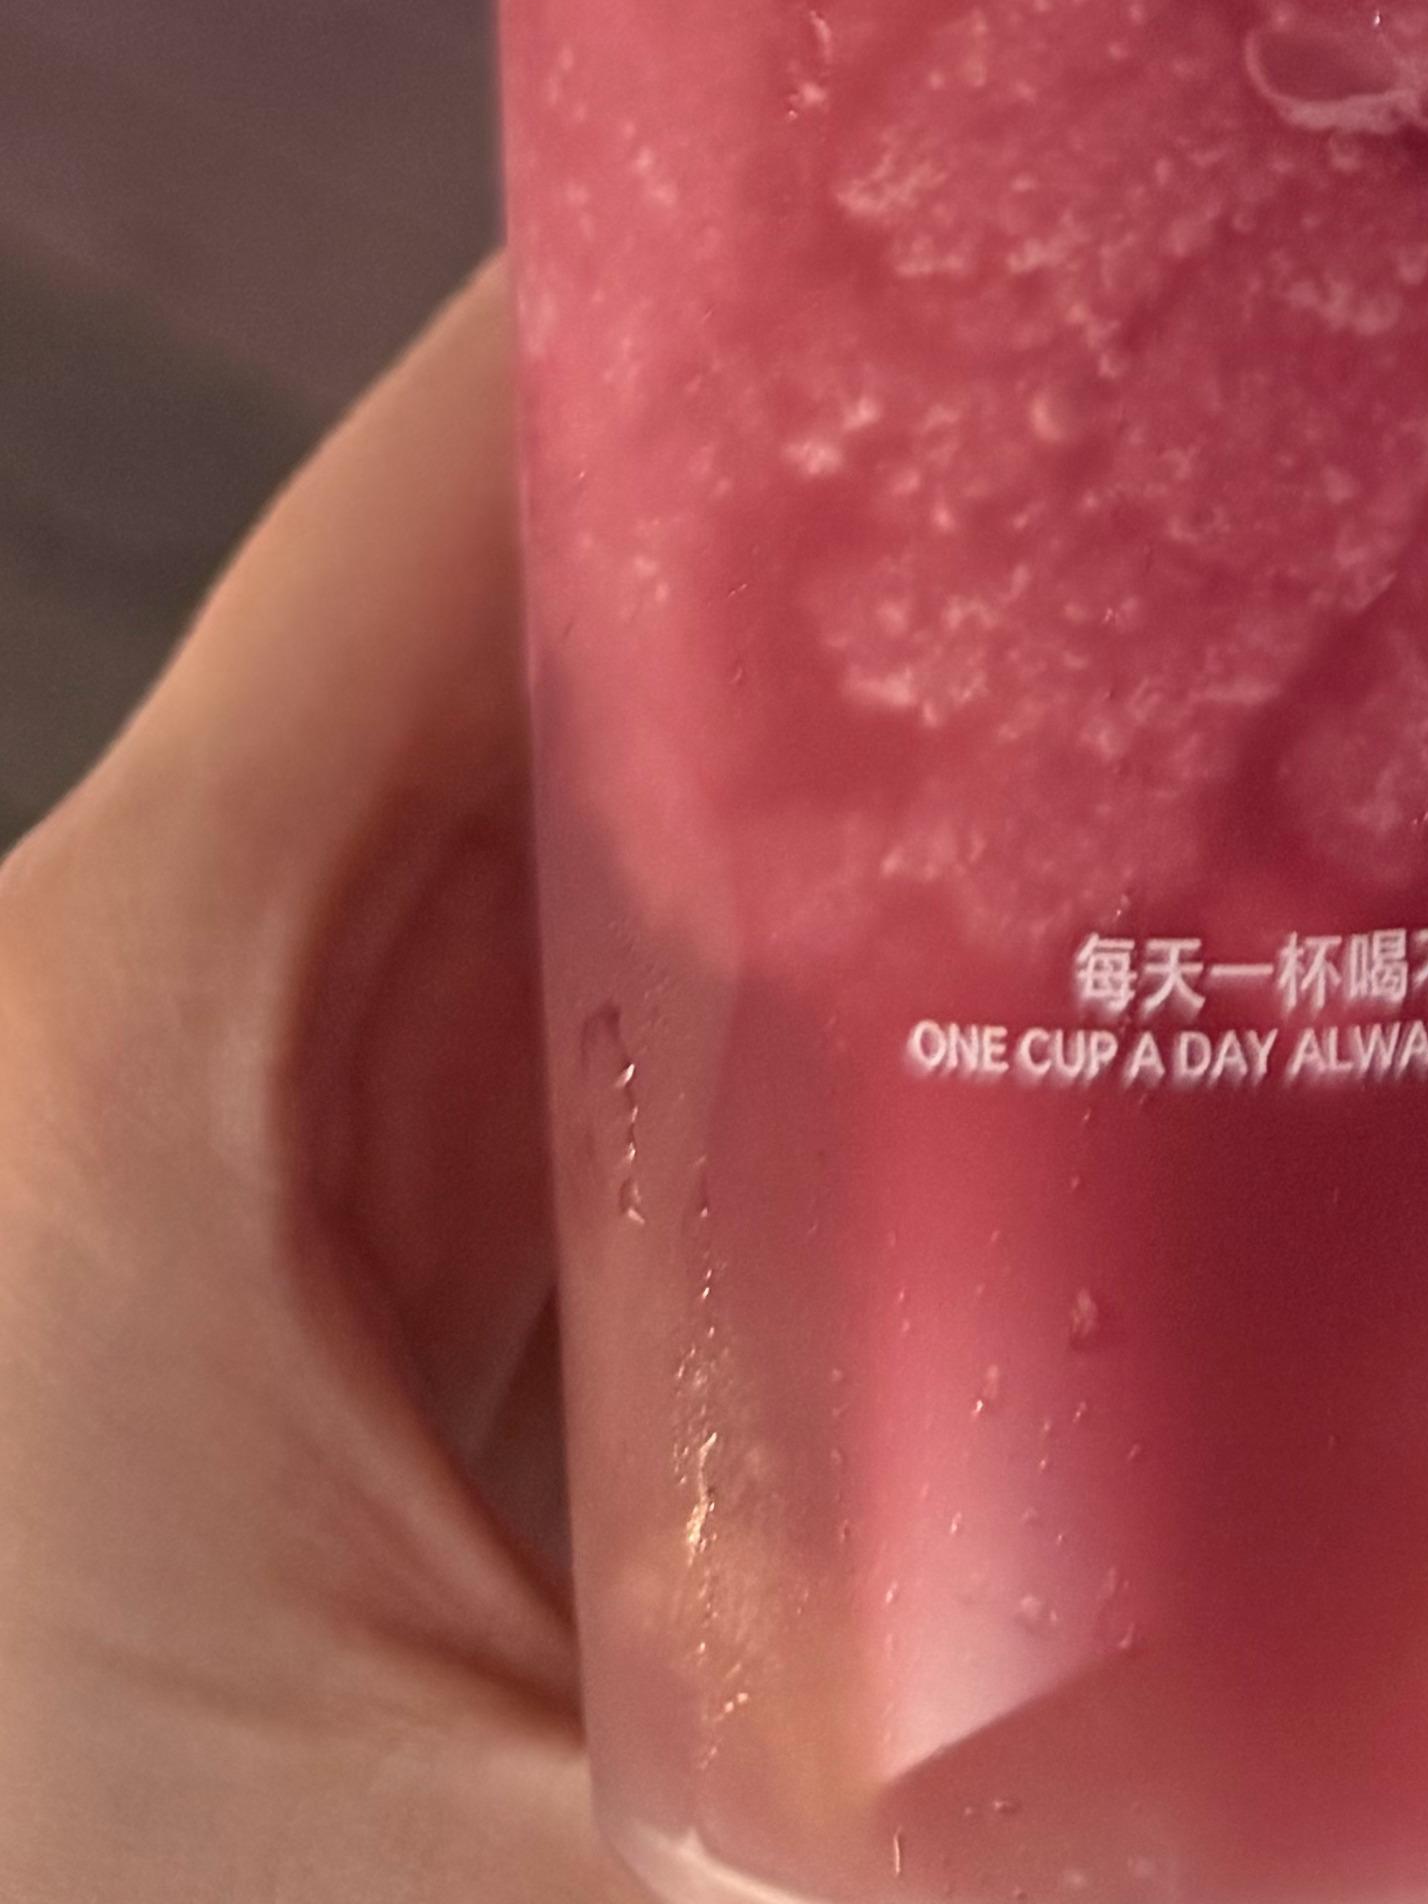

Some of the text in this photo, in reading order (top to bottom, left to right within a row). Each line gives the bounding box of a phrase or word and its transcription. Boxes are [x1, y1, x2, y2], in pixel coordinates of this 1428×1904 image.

[910, 1018, 1009, 1074] ONE
[1017, 1026, 1119, 1080] CUP
[1126, 1028, 1165, 1082] A
[1176, 1028, 1278, 1082] DAY
